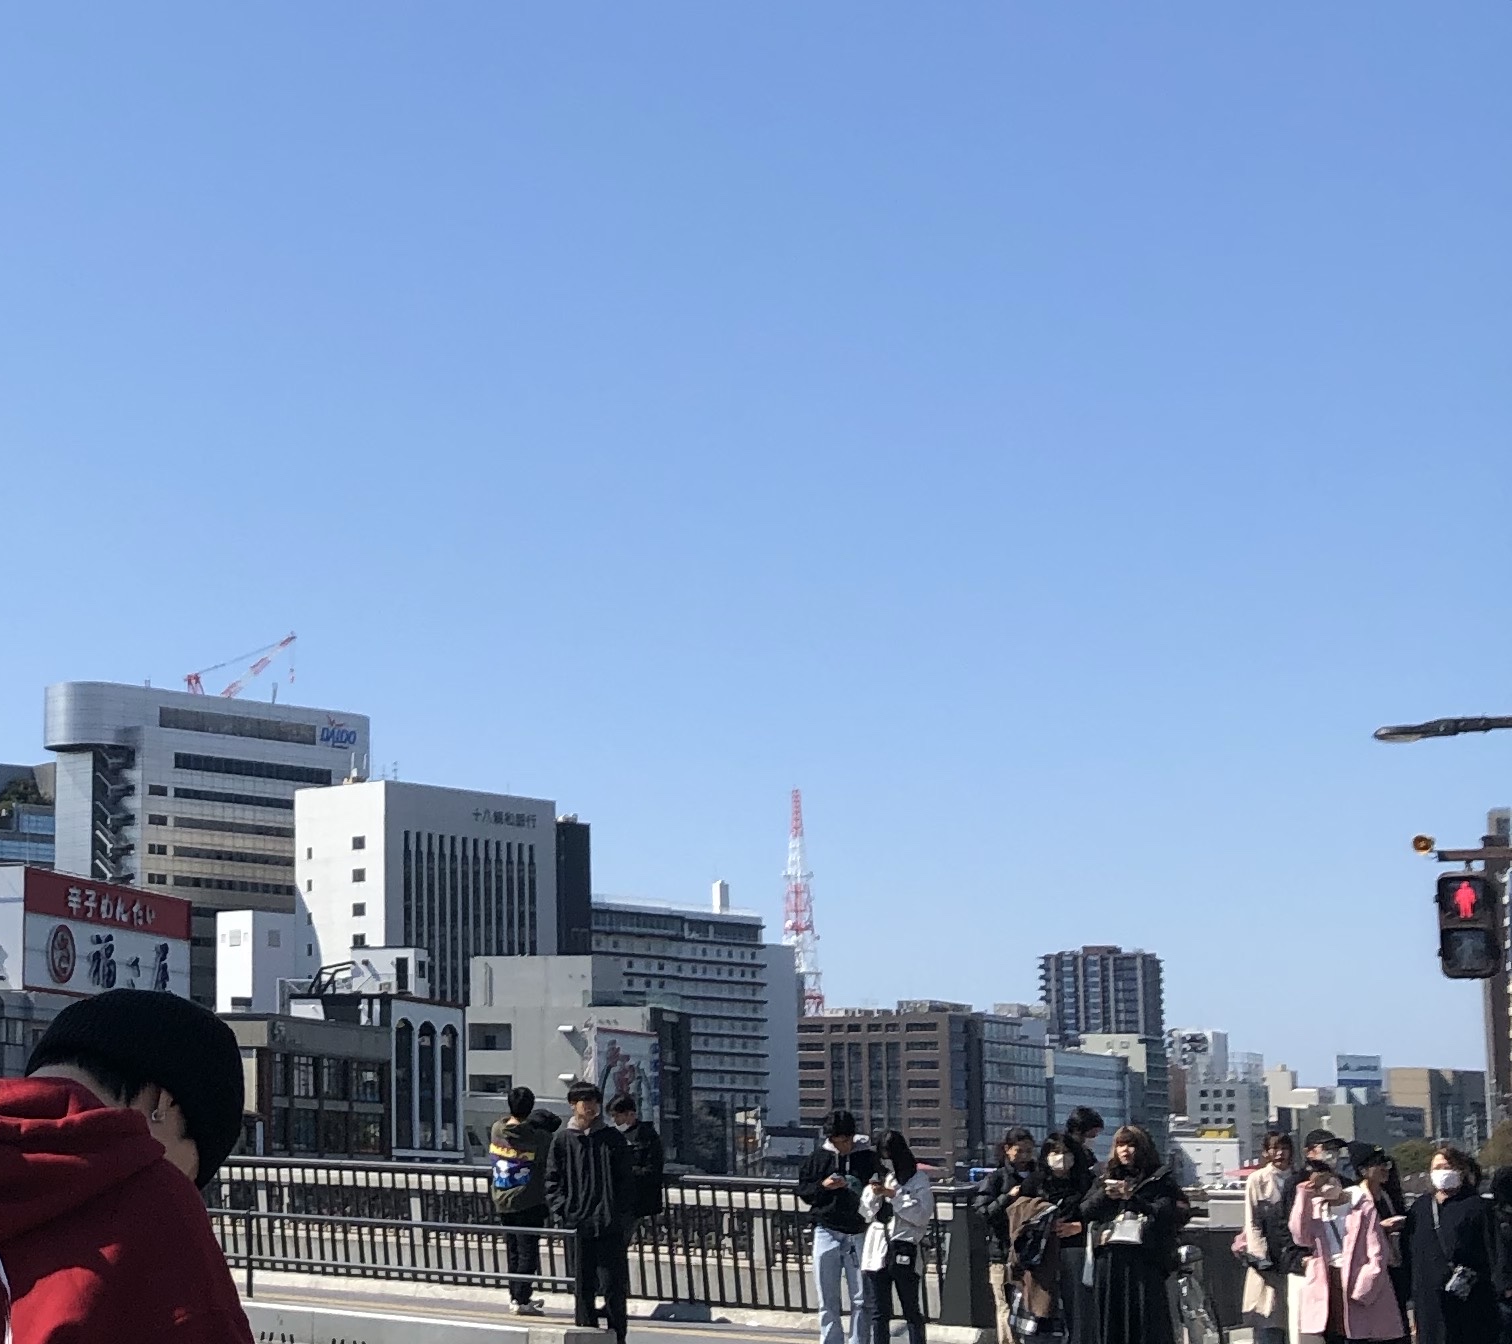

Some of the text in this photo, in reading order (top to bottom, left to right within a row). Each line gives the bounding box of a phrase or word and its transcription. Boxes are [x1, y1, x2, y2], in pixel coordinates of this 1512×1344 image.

[67, 886, 156, 927] 辛子めんたい
